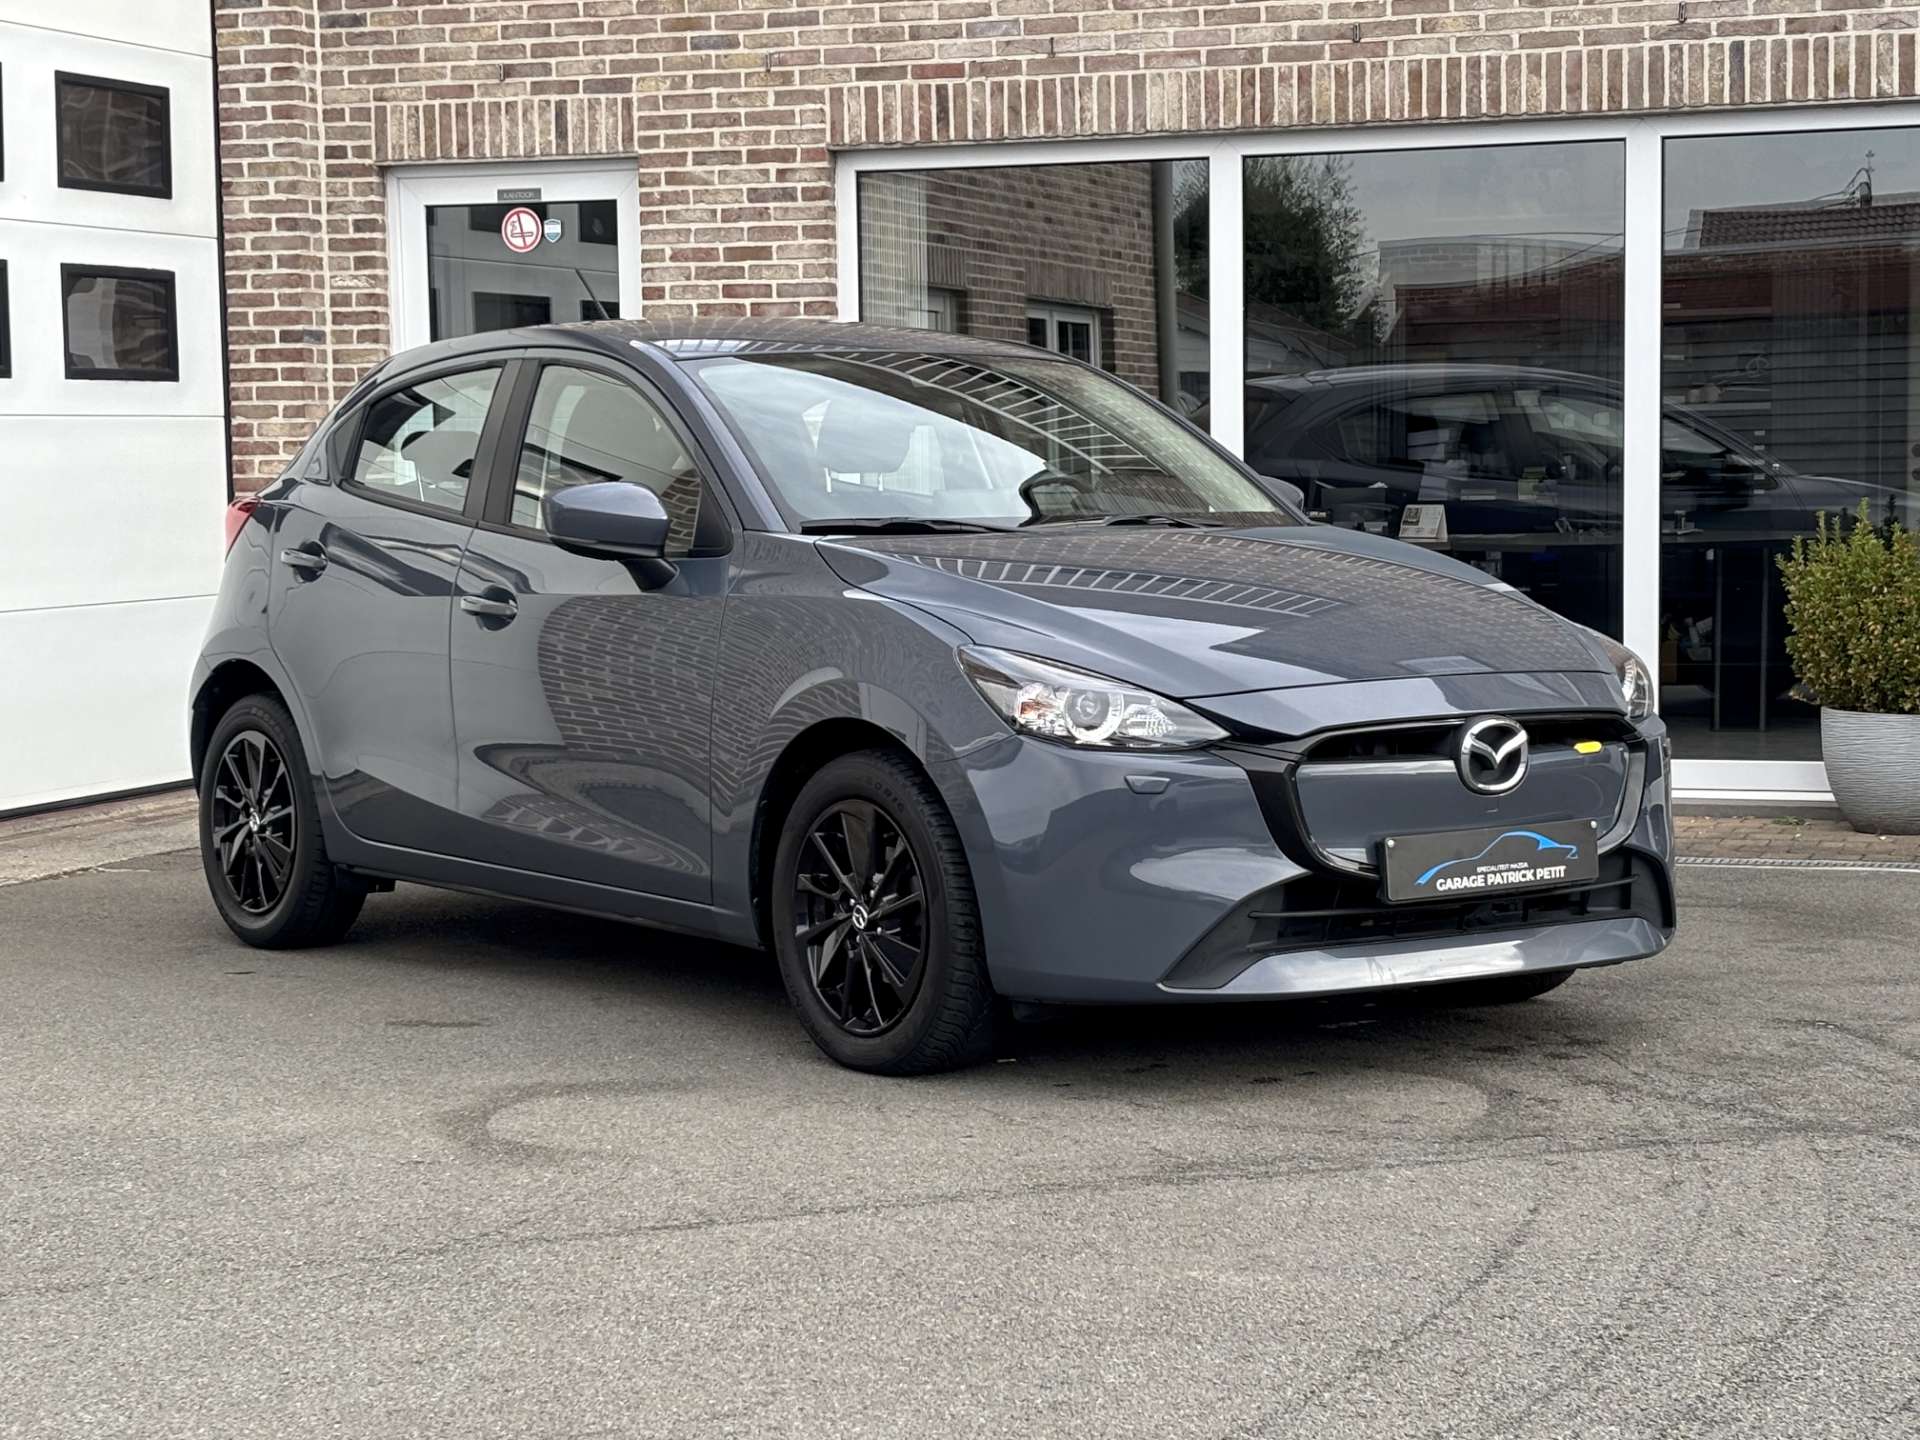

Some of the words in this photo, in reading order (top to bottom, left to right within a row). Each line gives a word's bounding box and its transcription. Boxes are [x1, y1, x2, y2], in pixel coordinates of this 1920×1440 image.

[1510, 861, 1529, 869] MAZDA
[1436, 875, 1486, 891] GARAGE
[1487, 869, 1535, 885] PATRICK
[1536, 865, 1567, 880] PETIT
